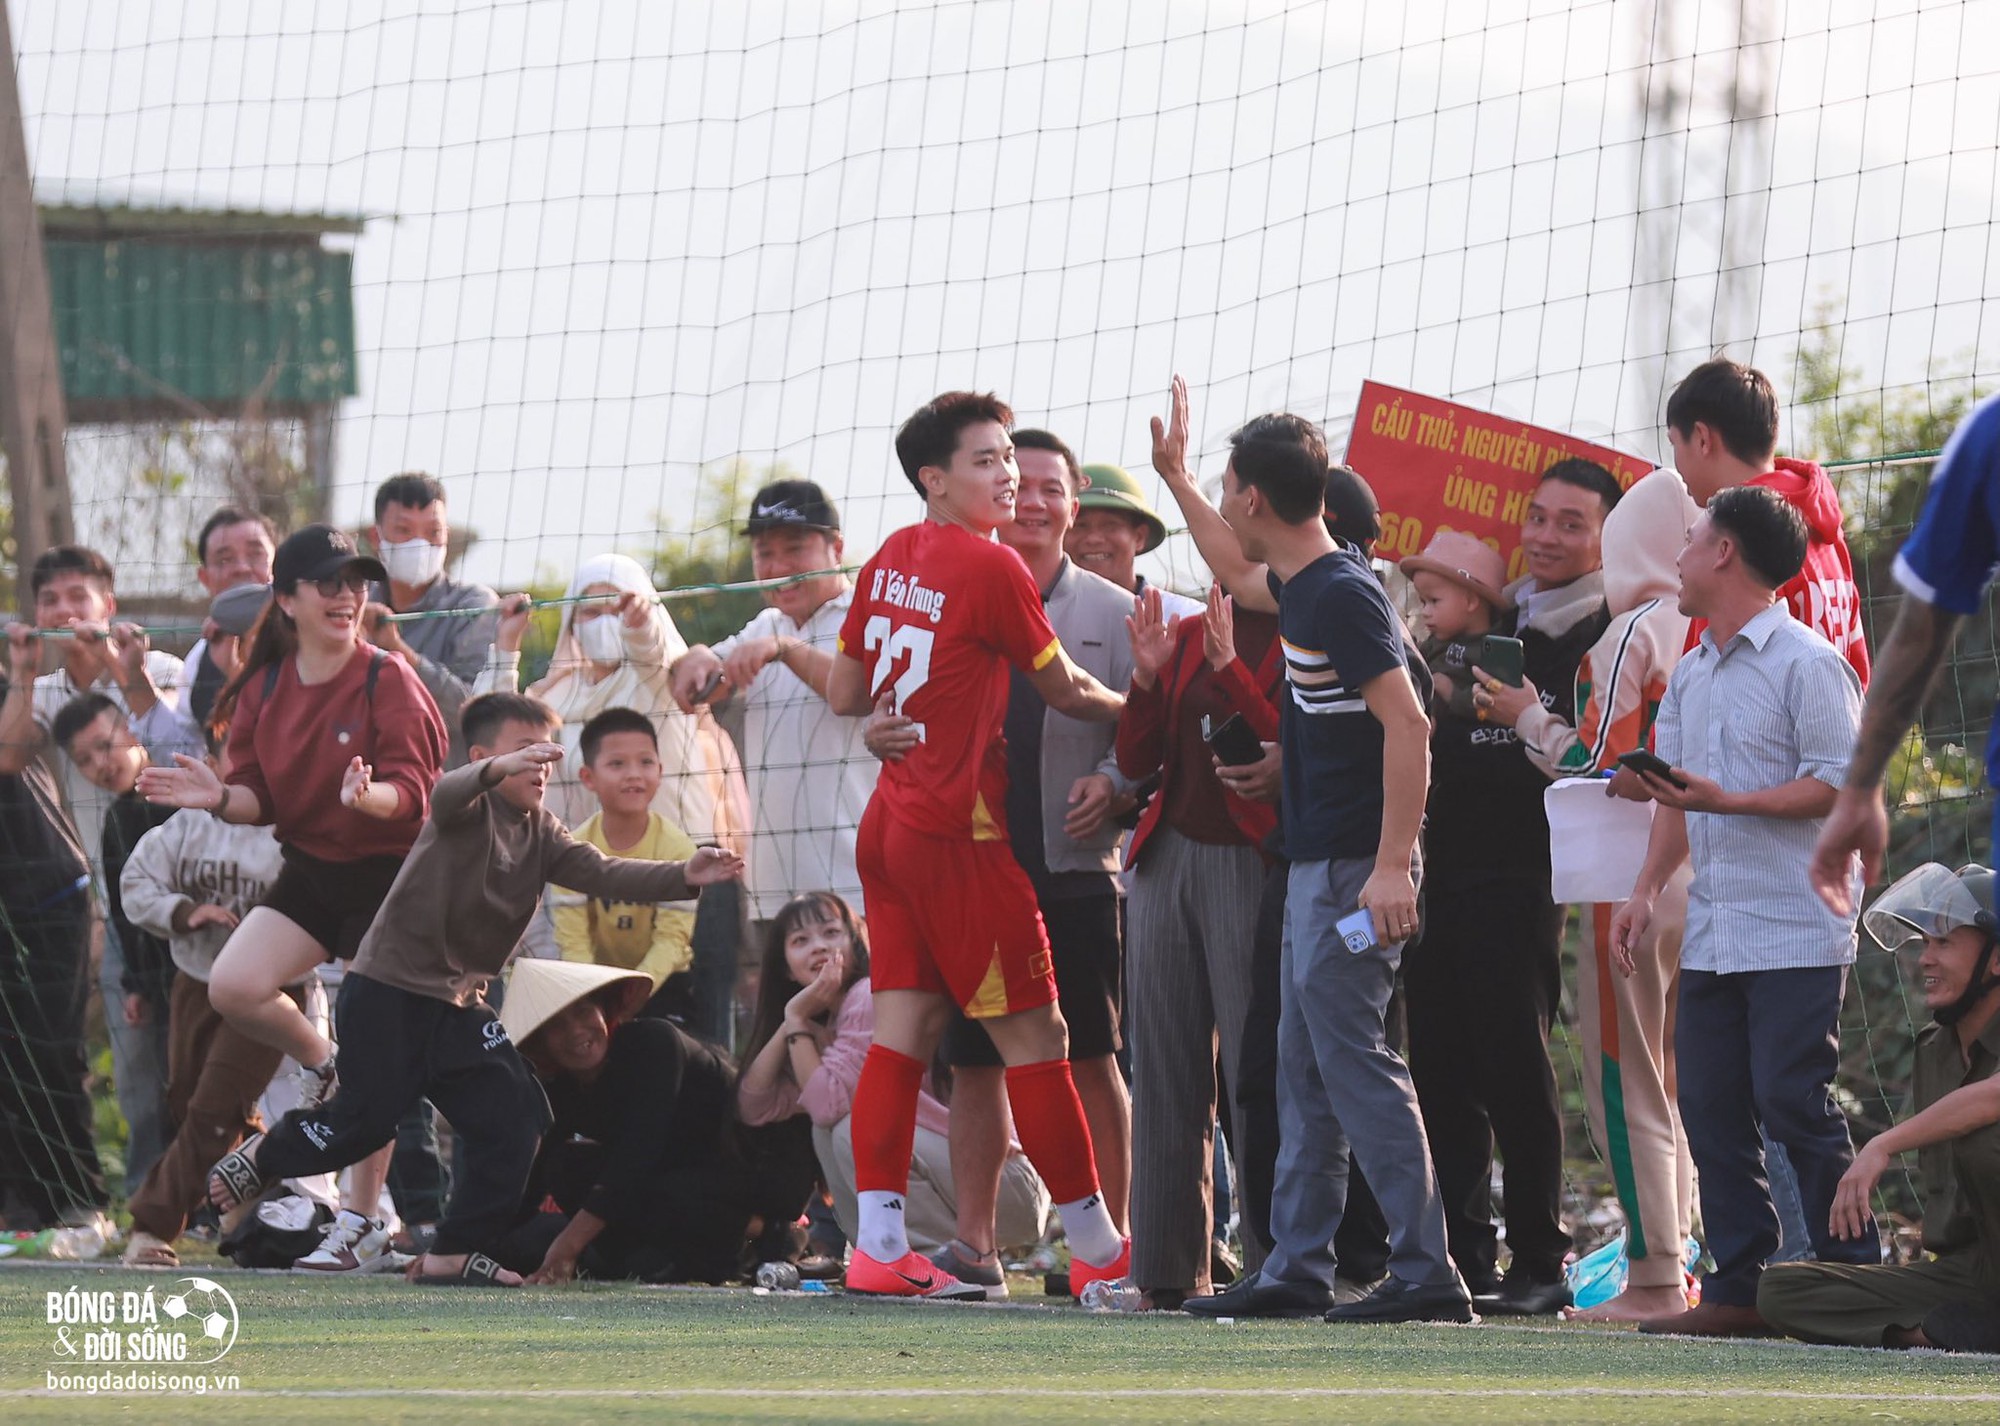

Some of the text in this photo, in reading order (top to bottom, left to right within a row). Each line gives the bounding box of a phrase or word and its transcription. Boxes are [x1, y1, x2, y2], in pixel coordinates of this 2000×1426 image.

[1371, 396, 1413, 440] CẦU
[1460, 426, 1542, 474] NGUYỄN
[1443, 464, 1498, 518] ỦNG
[904, 575, 946, 624] Trung
[864, 615, 935, 745] 22
